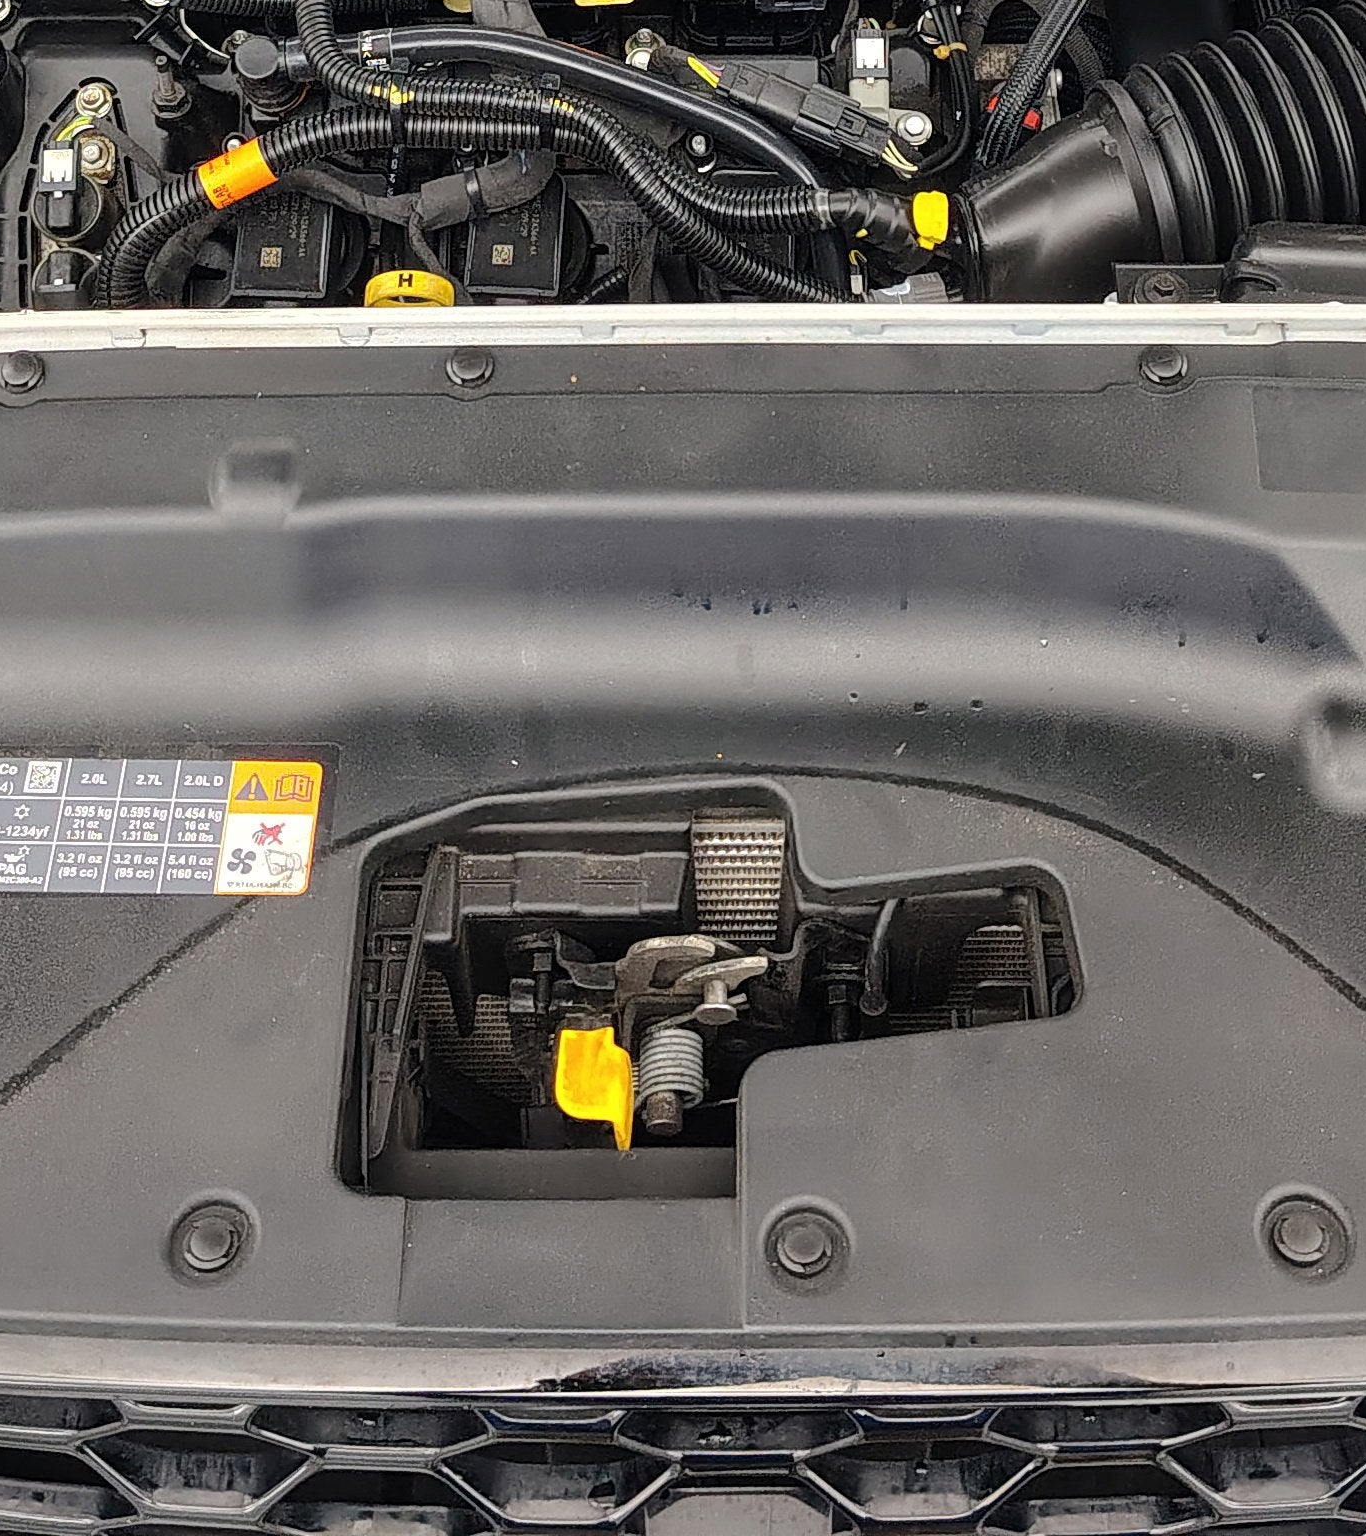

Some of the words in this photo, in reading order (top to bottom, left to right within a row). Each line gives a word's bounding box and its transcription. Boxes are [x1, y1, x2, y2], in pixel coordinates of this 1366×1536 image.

[398, 273, 414, 288] H
[81, 774, 107, 785] 2.0L
[136, 775, 162, 786] 2.7L
[184, 776, 210, 786] 2.0L
[214, 776, 223, 786] D
[64, 806, 97, 817] 0.595
[98, 806, 112, 820] kg
[120, 807, 152, 818] 0.595
[153, 807, 167, 821] kg
[175, 808, 206, 819] 0.454
[208, 808, 222, 822] kg
[73, 819, 84, 828] 21
[86, 821, 99, 829] oz
[129, 820, 139, 829] 21
[142, 822, 154, 830] oz
[198, 823, 210, 831] oz
[66, 830, 86, 840] 1.31
[122, 831, 140, 840] 1.31
[57, 853, 75, 863] 3.2
[88, 855, 102, 863] oz
[113, 854, 131, 864] 3.2
[144, 856, 158, 864] oz
[168, 855, 186, 865] 5.4
[199, 857, 213, 865] oz
[58, 867, 77, 879] (95
[80, 867, 97, 879] cc)
[115, 868, 133, 880] (95
[136, 868, 154, 880] cc)
[167, 869, 192, 881] (160
[194, 869, 212, 881] cc)
